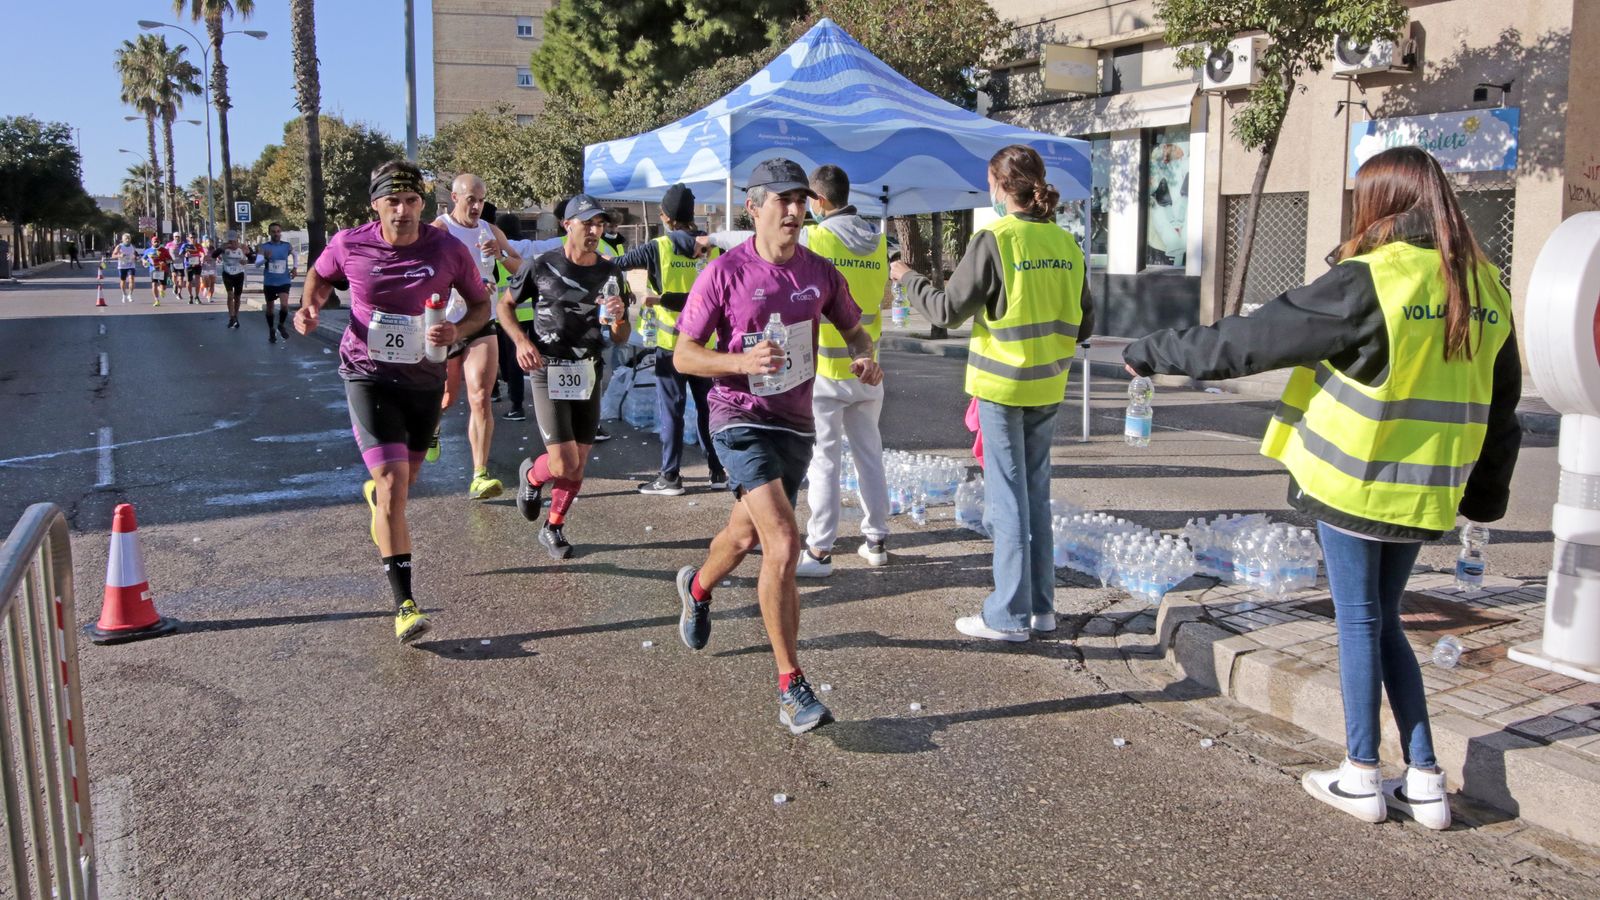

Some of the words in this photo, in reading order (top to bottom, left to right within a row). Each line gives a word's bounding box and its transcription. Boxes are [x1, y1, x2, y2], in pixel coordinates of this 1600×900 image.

[385, 333, 405, 348] 26
[744, 335, 758, 346] XXV
[558, 374, 581, 387] 330
